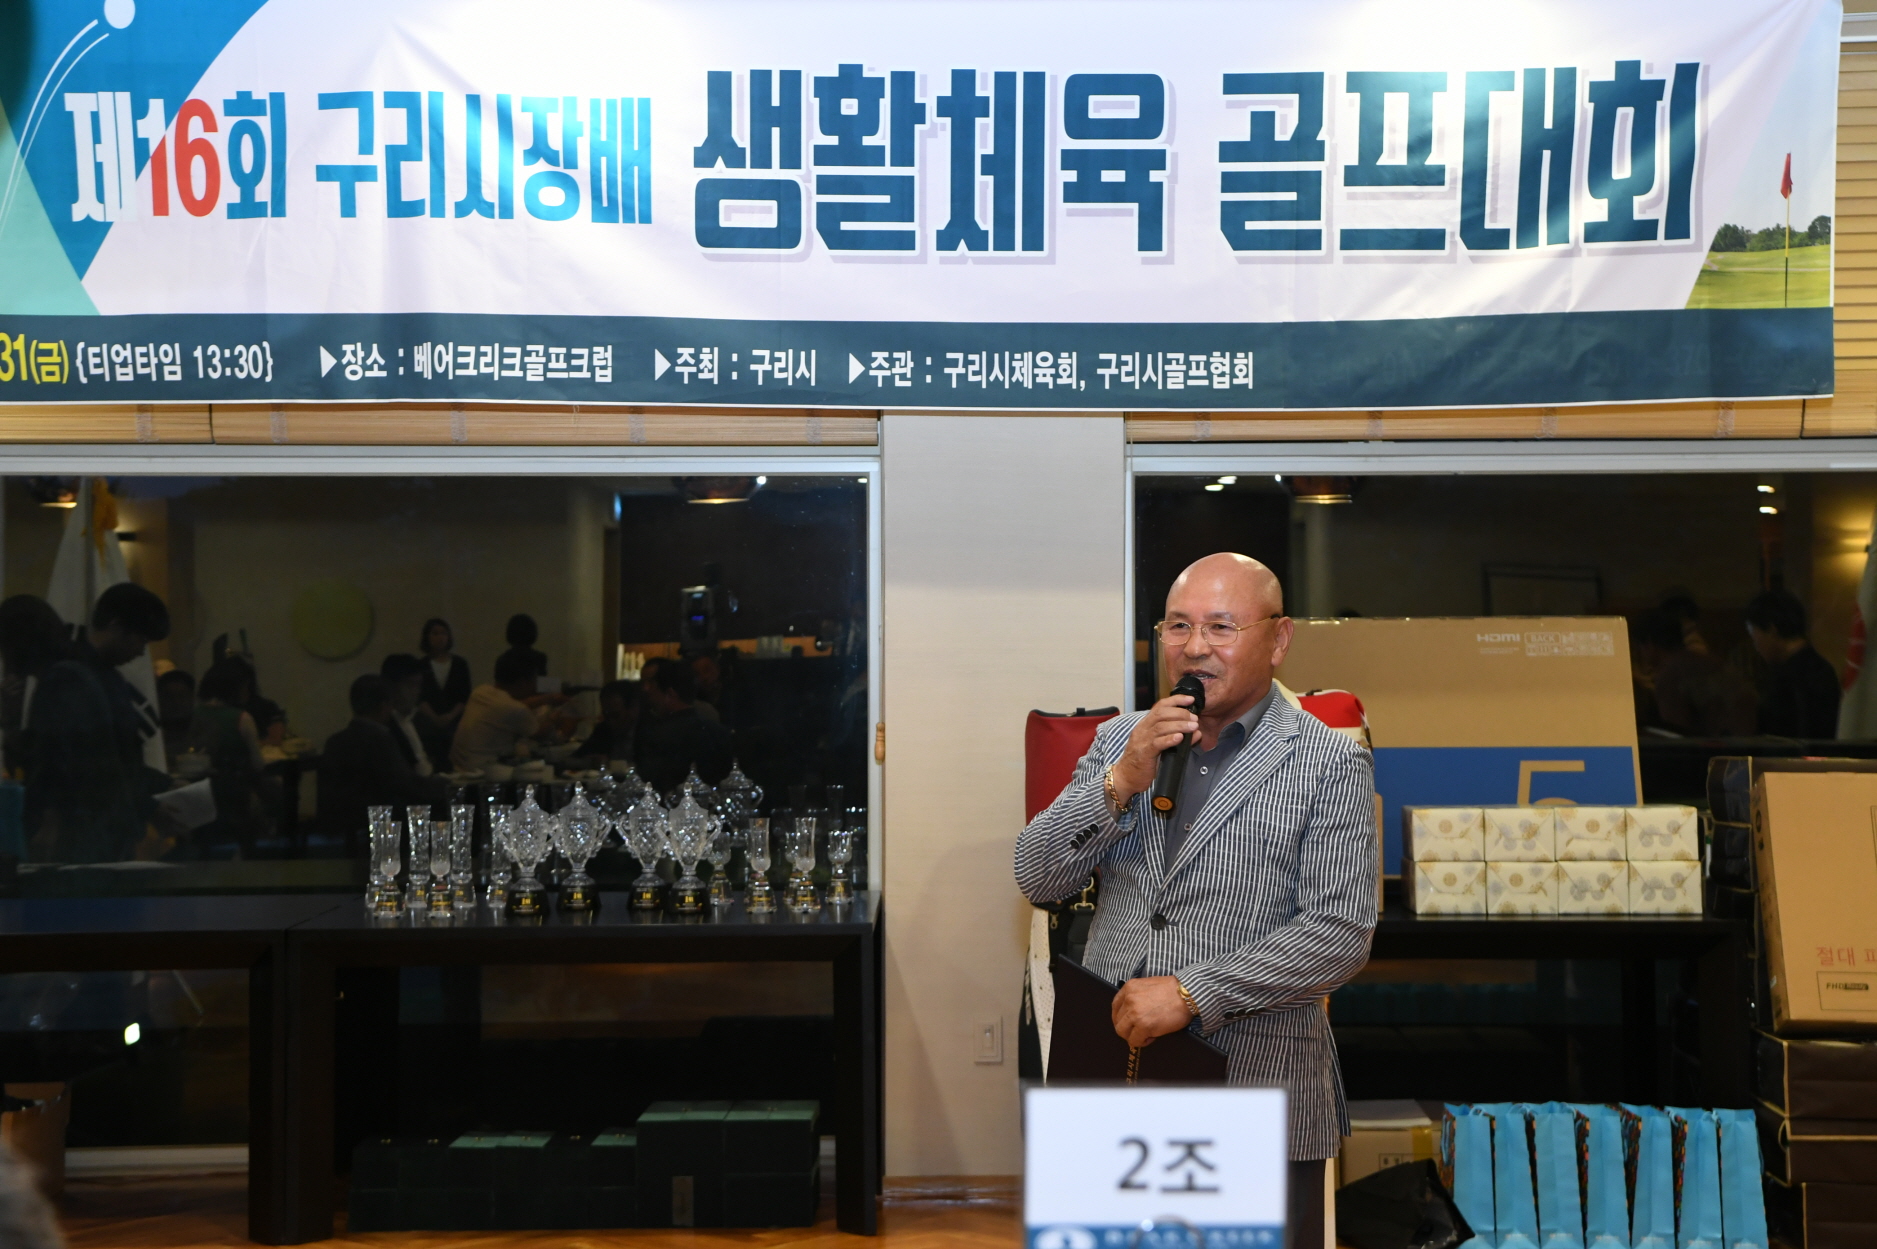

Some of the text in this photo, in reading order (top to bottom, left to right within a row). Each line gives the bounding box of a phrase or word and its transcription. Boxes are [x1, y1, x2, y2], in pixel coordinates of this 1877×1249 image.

[64, 59, 1701, 253] 제16회 구리시장배 생활체육 골프대회
[76, 341, 182, 384] {티업타임
[193, 341, 274, 383] 13:30}
[341, 342, 388, 381] 장소
[413, 341, 613, 383] 베어크리크골프크럽
[675, 347, 719, 385] 주최
[750, 349, 816, 386] 구리시
[869, 351, 914, 387] 주관
[944, 351, 1086, 391] 구리시체육회,
[1097, 351, 1254, 389] 구리시골프협회
[1116, 1135, 1221, 1194] 2조
